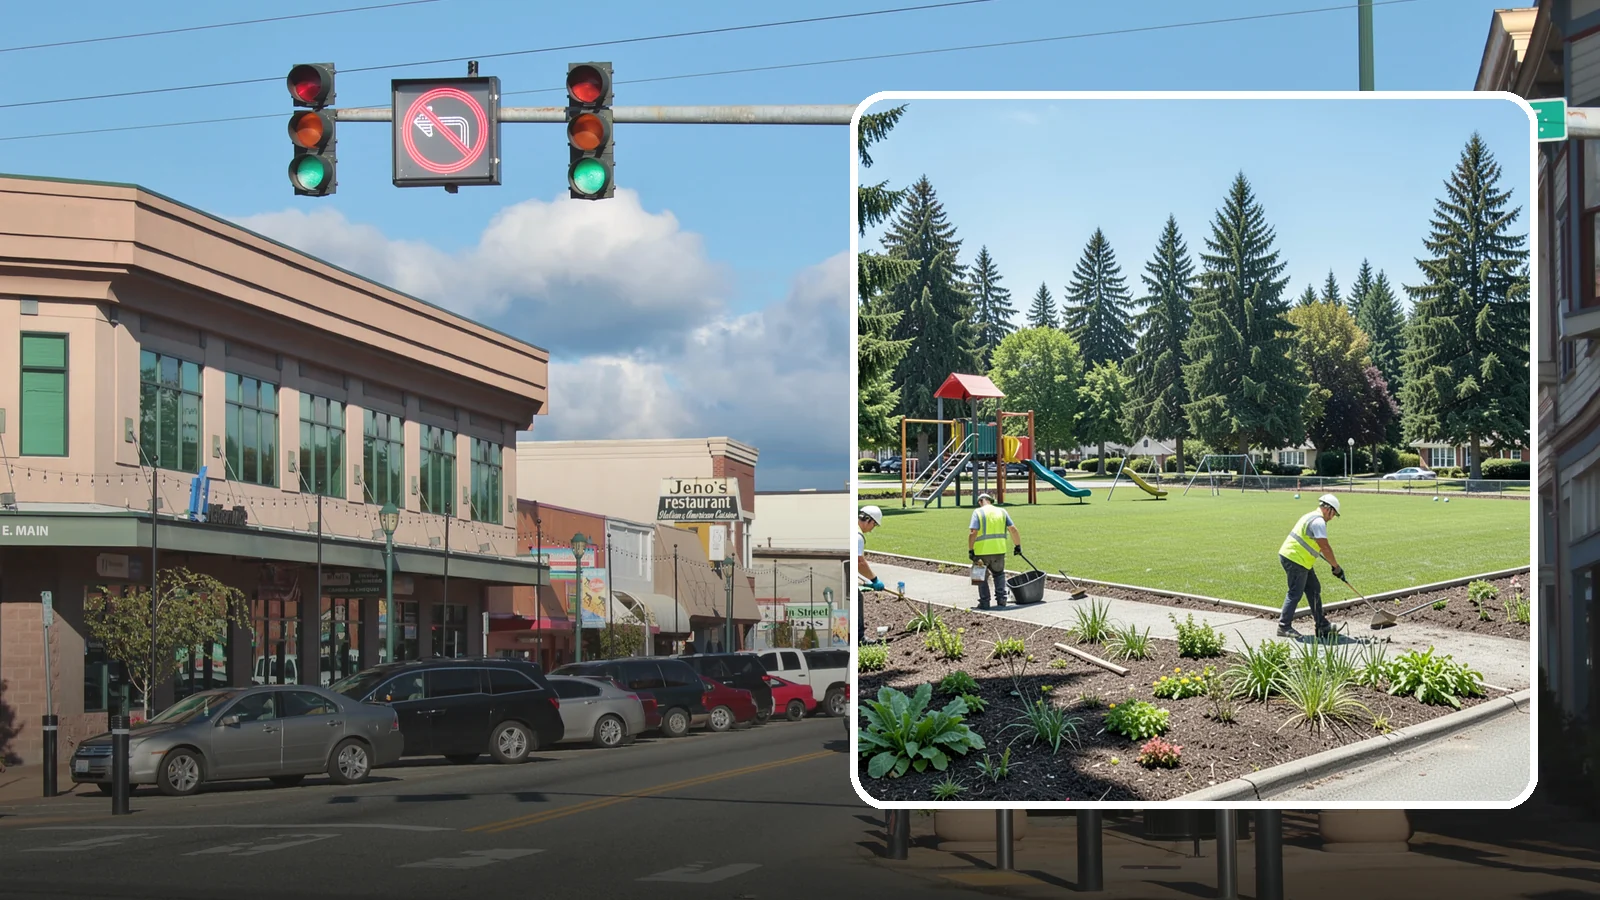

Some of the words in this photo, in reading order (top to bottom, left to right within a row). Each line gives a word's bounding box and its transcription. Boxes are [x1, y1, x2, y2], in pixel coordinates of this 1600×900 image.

[669, 480, 727, 494] Jeno's
[665, 496, 731, 509] restaurant
[658, 510, 681, 519] Italian
[686, 510, 714, 519] American
[715, 510, 737, 519] Cuisine
[2, 525, 13, 536] E.
[15, 525, 49, 536] MAIN
[797, 607, 828, 617] Street
[791, 619, 823, 627] lass
